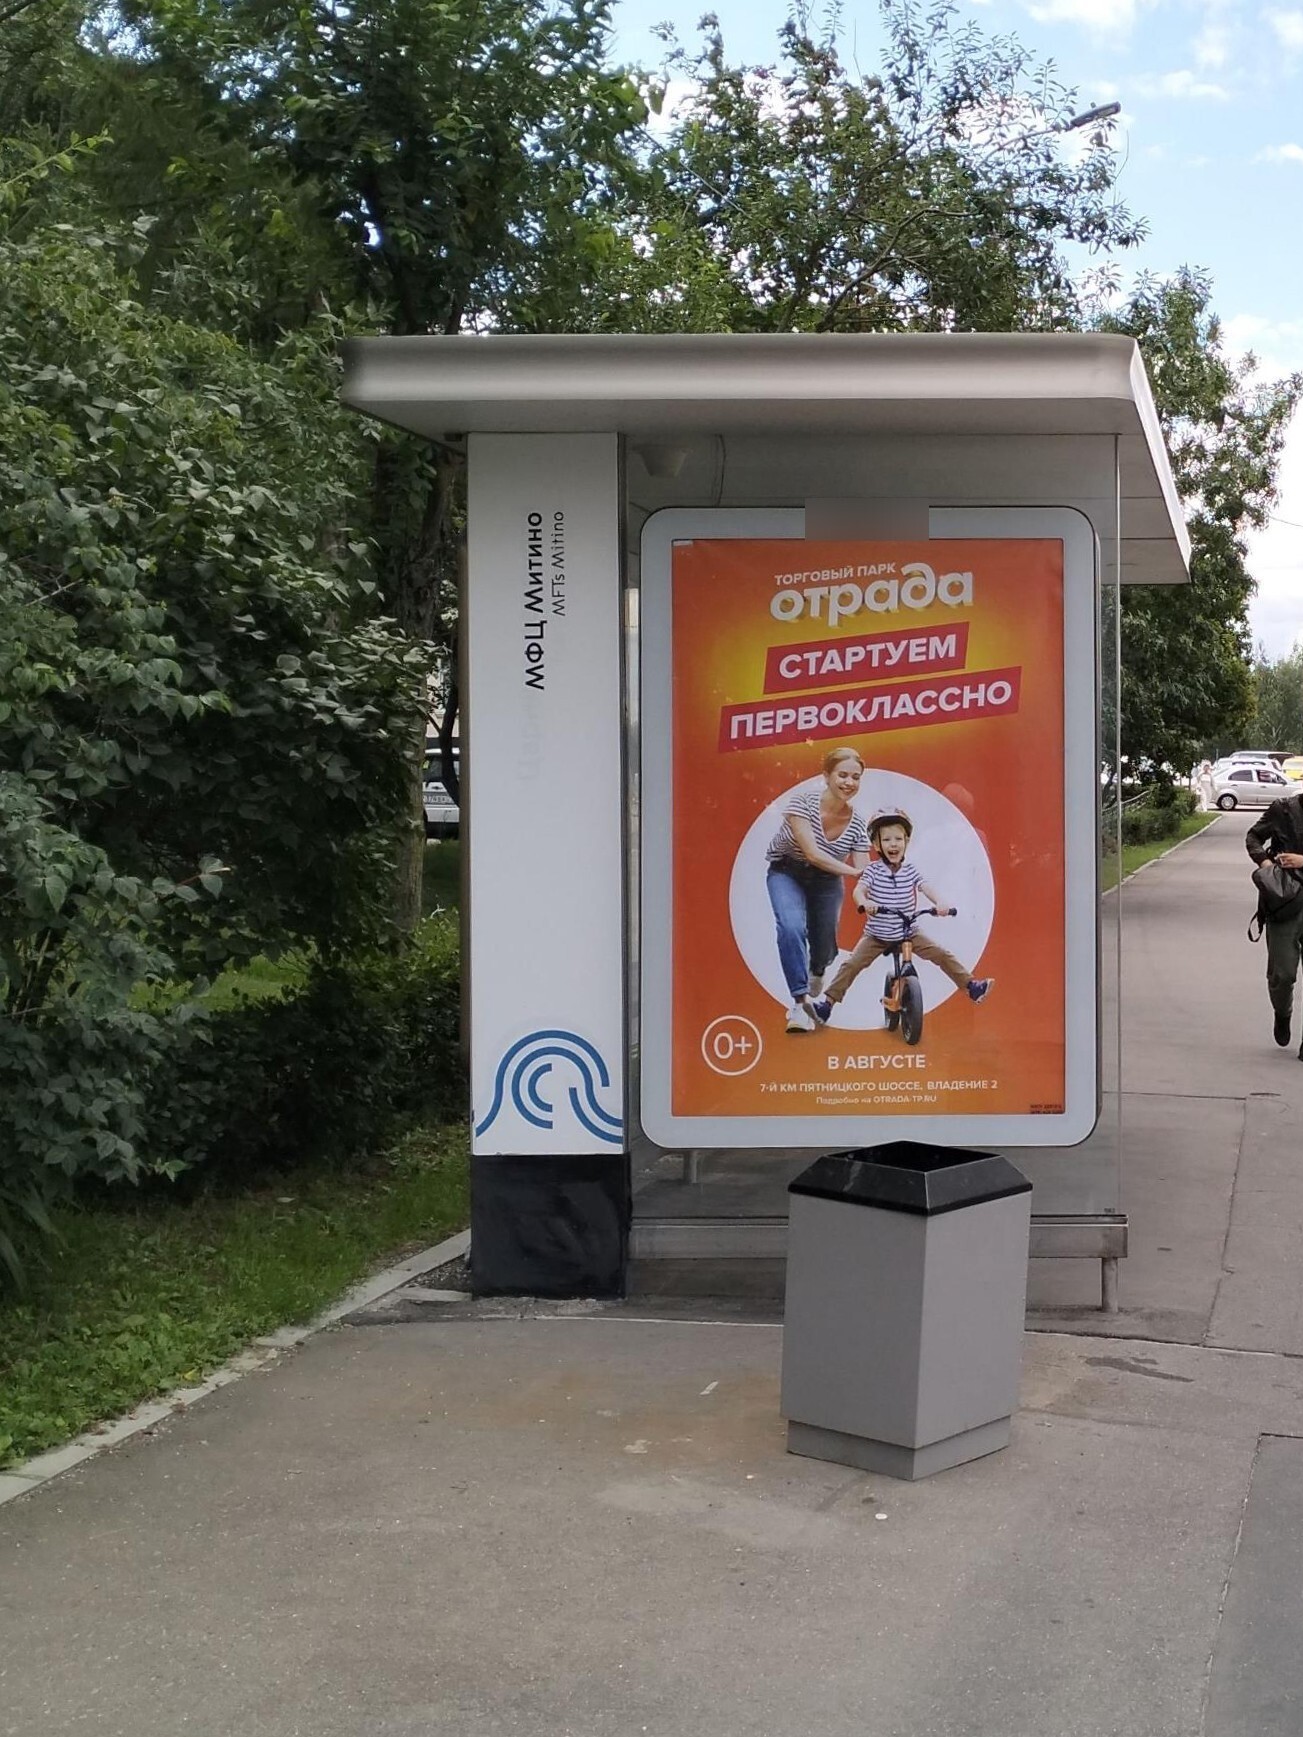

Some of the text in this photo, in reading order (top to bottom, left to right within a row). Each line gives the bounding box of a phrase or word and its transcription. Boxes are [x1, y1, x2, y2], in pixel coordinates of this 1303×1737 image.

[523, 511, 543, 613] Митино
[550, 511, 566, 617] MFTs Mitino
[774, 562, 896, 586] ТОРГОВЫЙ ПАРК
[769, 562, 974, 627] отрада
[524, 620, 547, 690] МФЦ
[779, 633, 957, 679] СТАРТУЕМ
[730, 680, 1012, 740] ПЕРВОКЛАССНО
[713, 1032, 752, 1059] 0+
[828, 1054, 926, 1069] В АВГУСТЕ
[760, 1081, 778, 1092] 7-Й
[780, 1082, 797, 1092] КМ
[799, 1081, 876, 1092] ПЯТНИЦКОГО
[927, 1080, 988, 1090] ВЛАДЕНИЕ
[991, 1080, 998, 1089] 2
